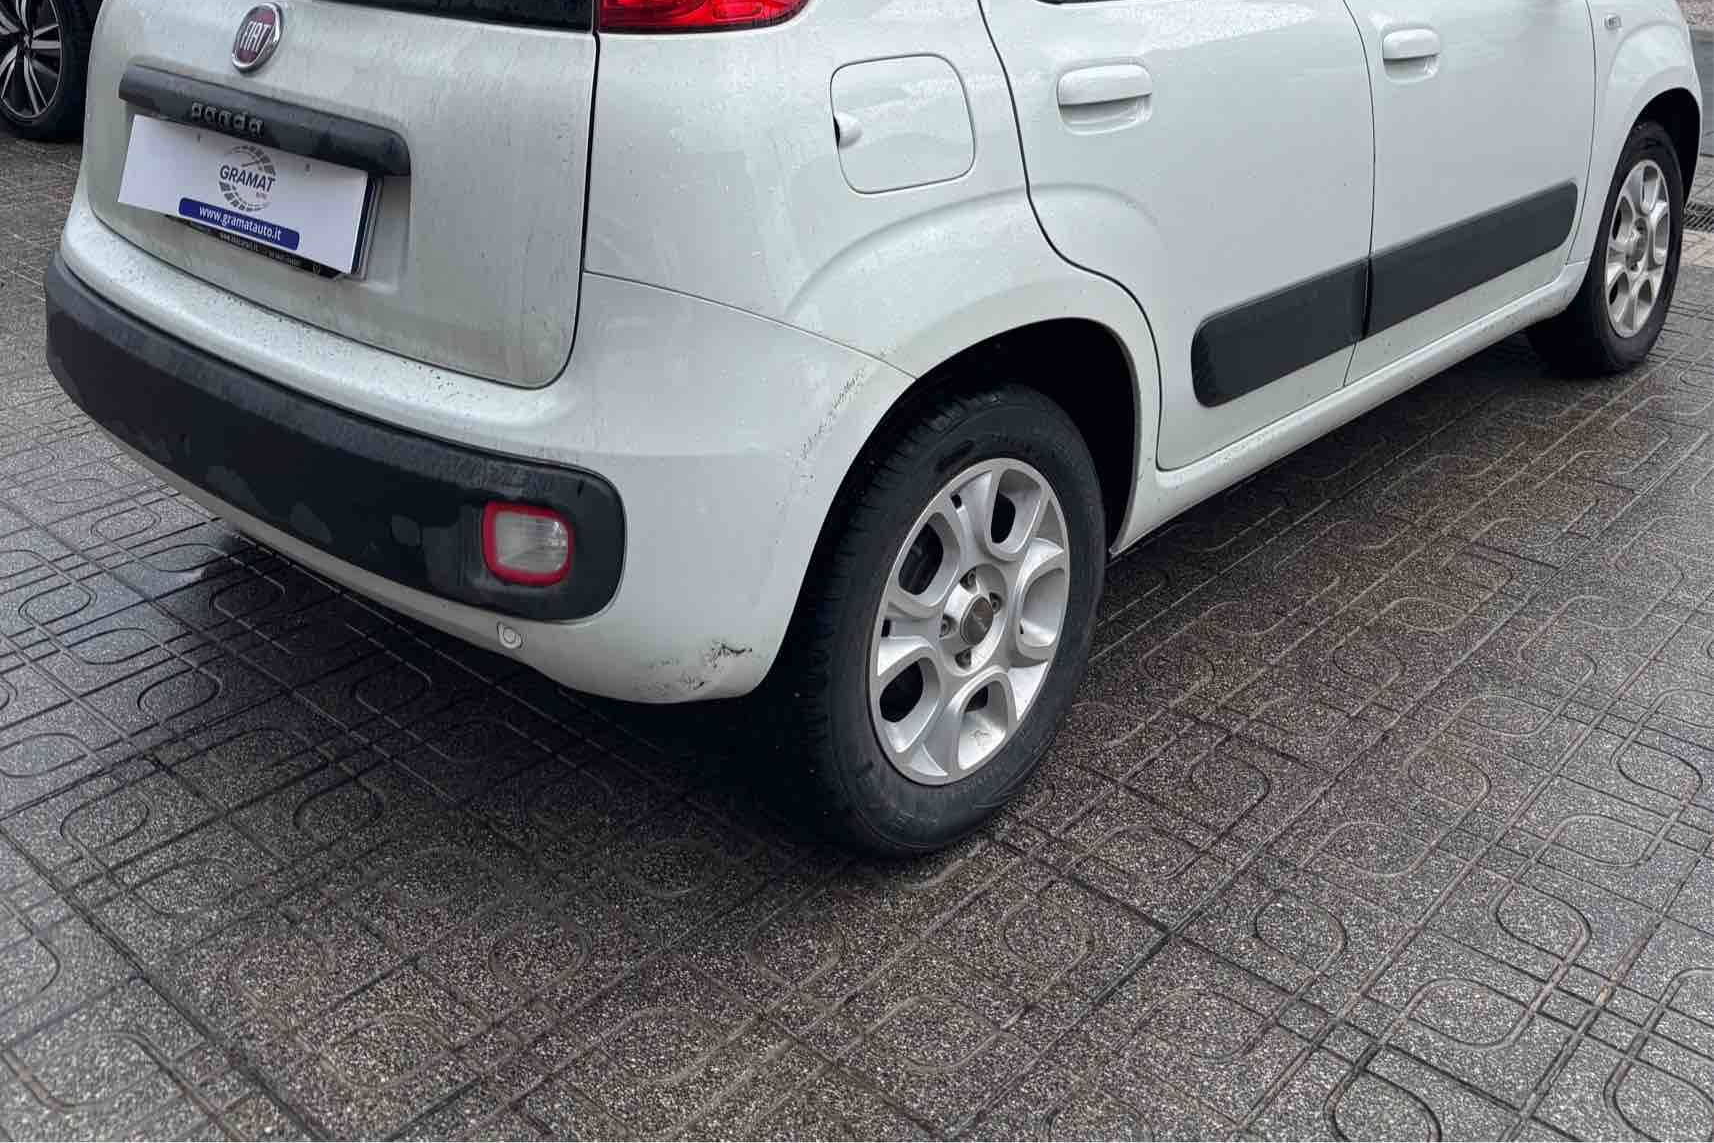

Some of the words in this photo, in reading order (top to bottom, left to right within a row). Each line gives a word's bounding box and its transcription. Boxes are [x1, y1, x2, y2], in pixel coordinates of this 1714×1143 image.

[239, 20, 273, 51] FIAT
[220, 164, 276, 193] GRAMAT
[198, 204, 282, 241] www.gramatauto.it
